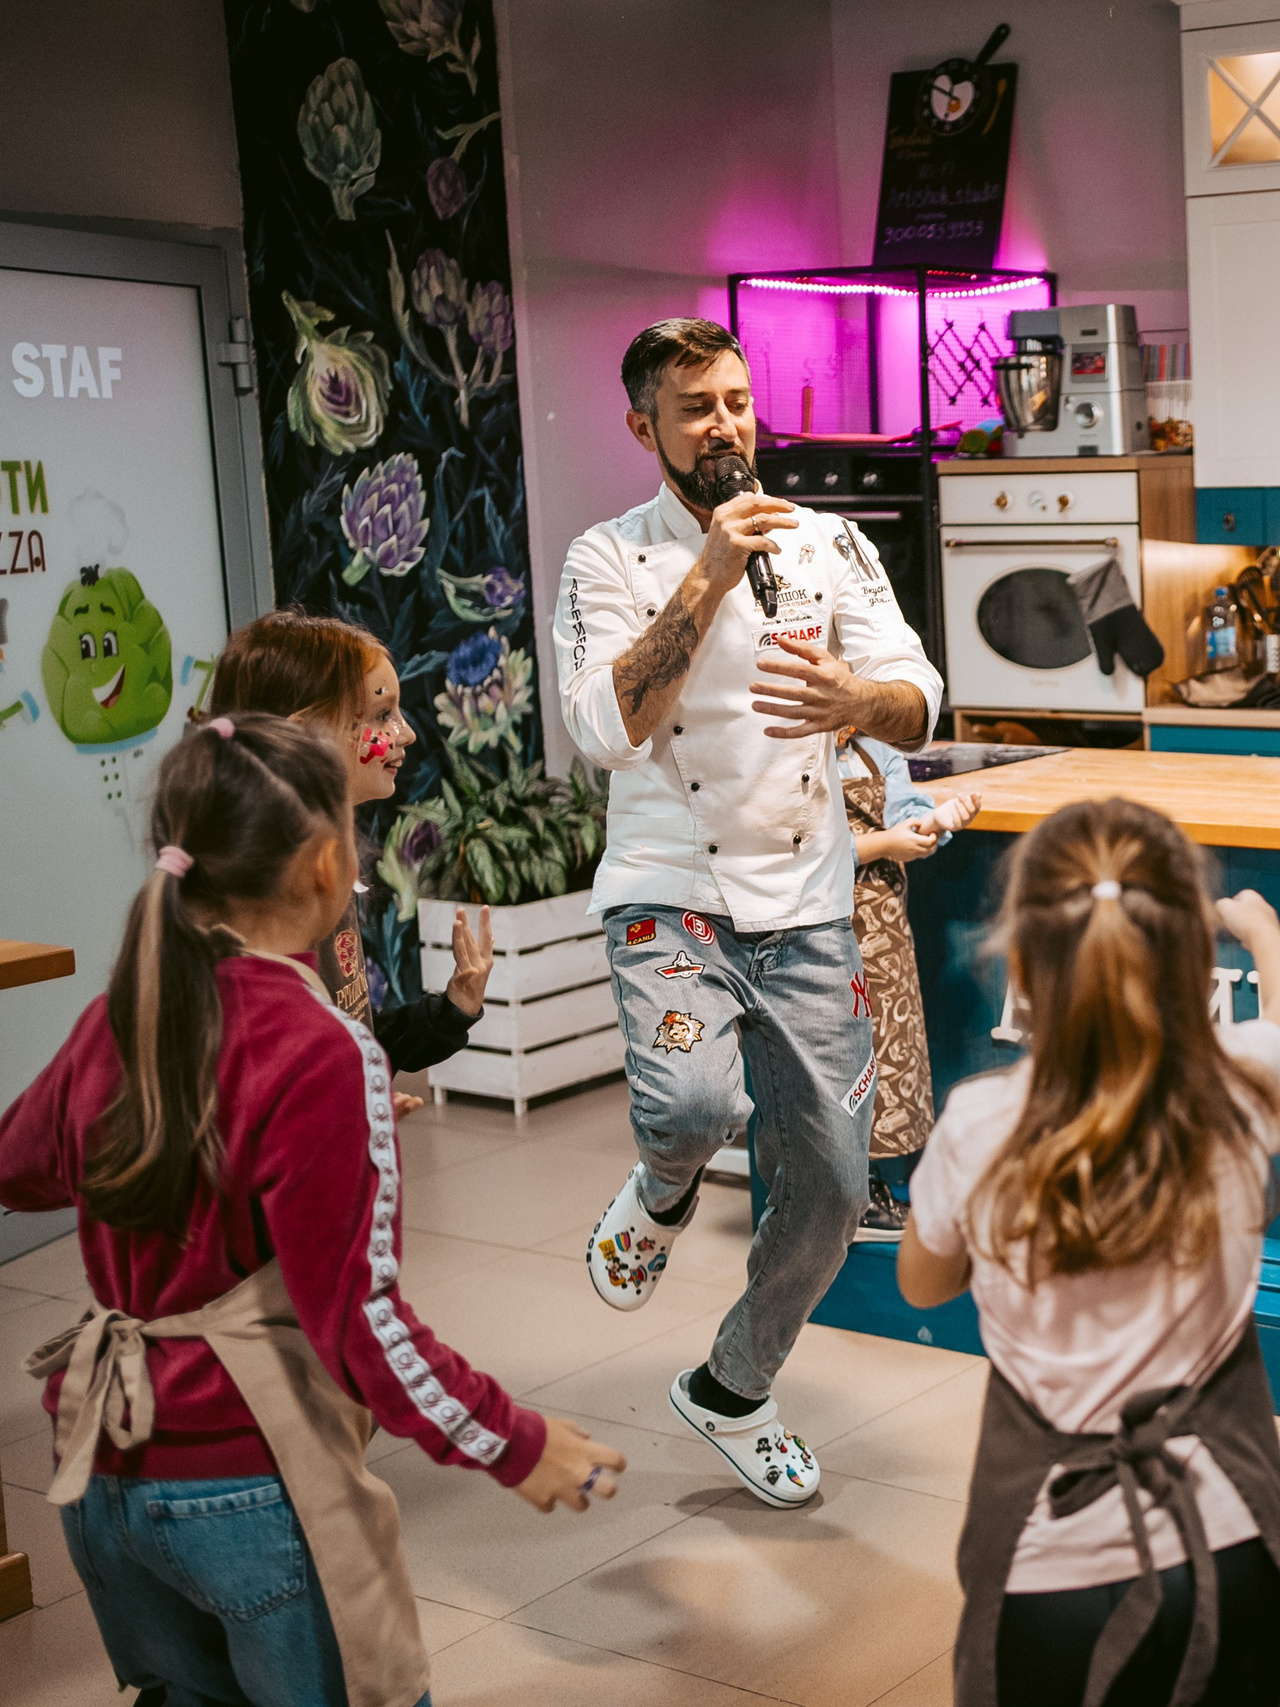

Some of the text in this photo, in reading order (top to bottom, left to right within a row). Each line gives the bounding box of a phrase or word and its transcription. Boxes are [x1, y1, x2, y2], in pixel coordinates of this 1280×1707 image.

[11, 341, 123, 399] STAF
[0, 459, 49, 515] ТИ
[853, 1055, 876, 1100] SCHAR
